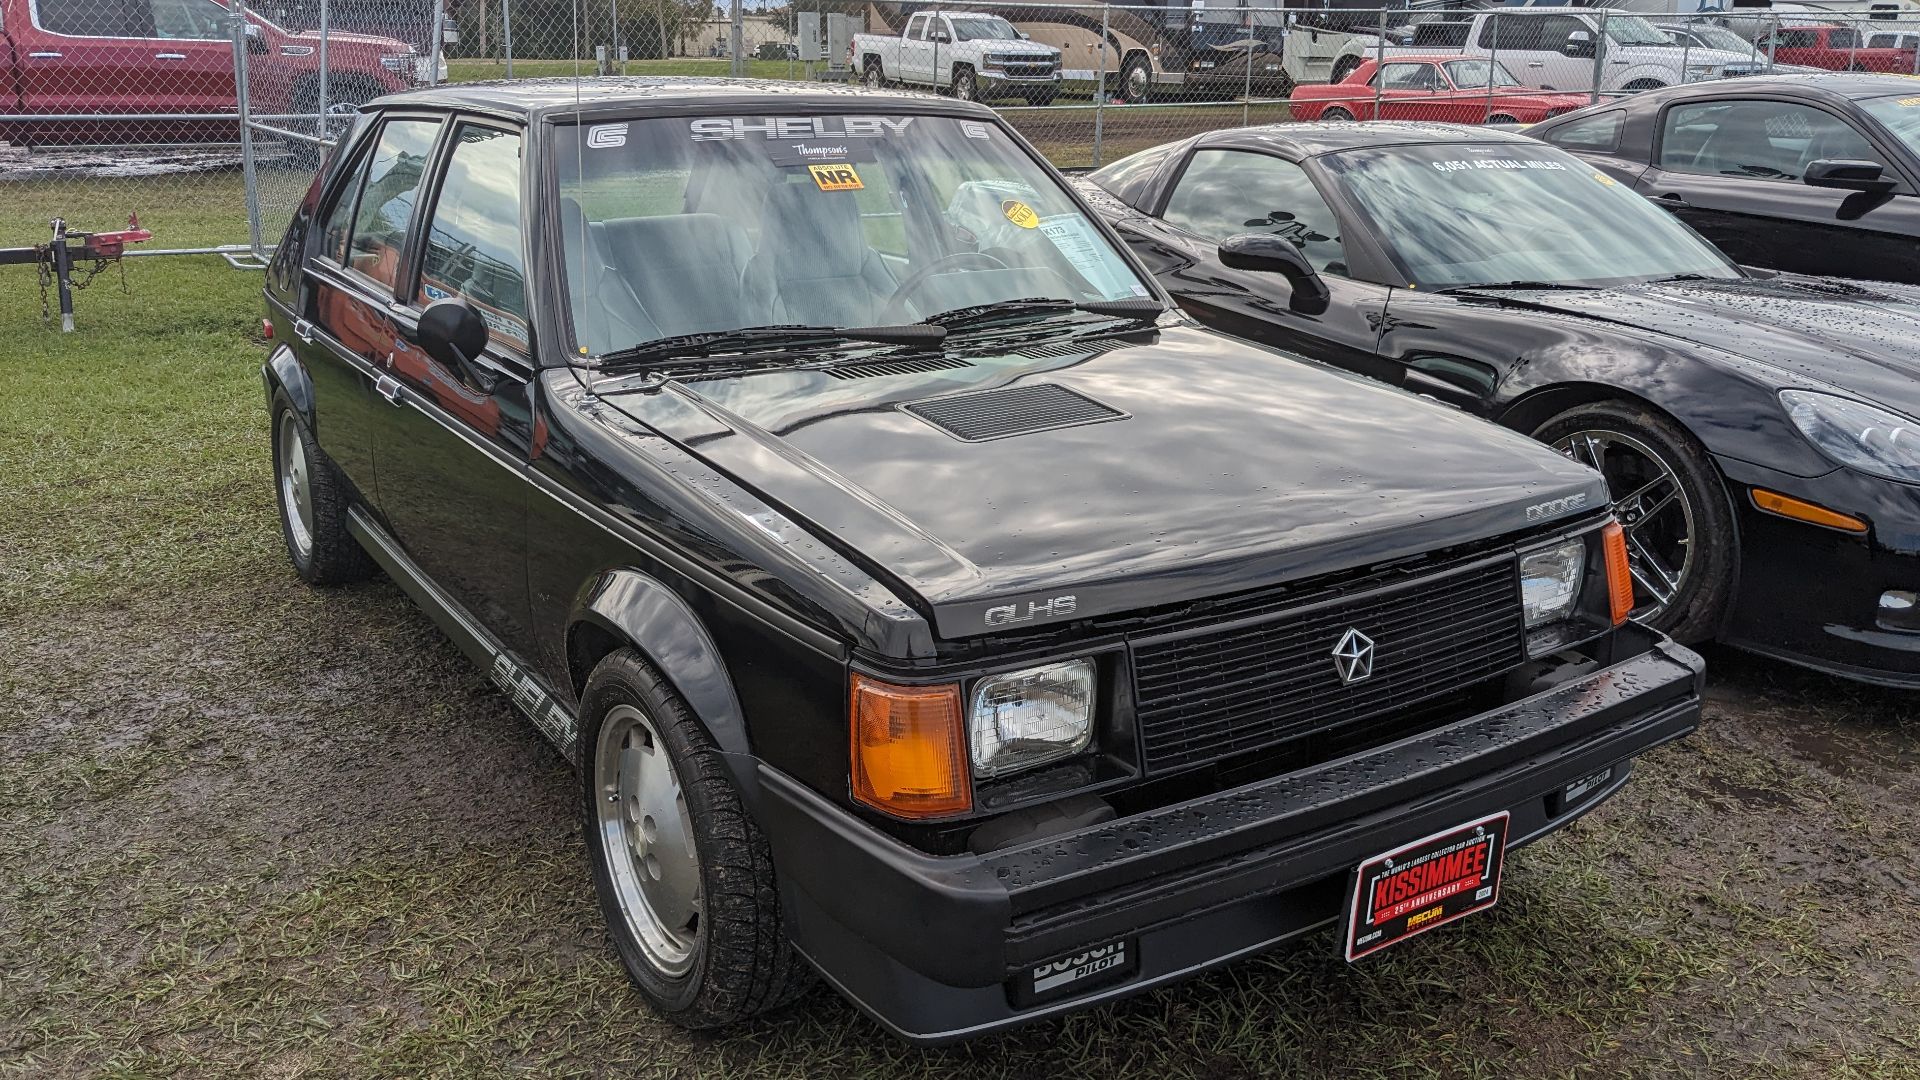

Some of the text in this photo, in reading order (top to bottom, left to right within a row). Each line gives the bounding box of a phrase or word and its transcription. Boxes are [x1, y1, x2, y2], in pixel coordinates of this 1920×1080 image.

[690, 117, 915, 142] SHELBY
[792, 143, 848, 157] Thompson's
[815, 170, 858, 185] NR
[1432, 160, 1566, 173] 6,051 ACTUAL MILES
[1014, 207, 1033, 226] SOLD
[1043, 226, 1066, 236] K173
[985, 595, 1077, 626] GLHS
[1374, 842, 1488, 910] KISSIMMEE
[1410, 883, 1461, 909] ANNIVERSARY
[1407, 905, 1443, 927] MECUM
[1075, 955, 1117, 978] PILOT
